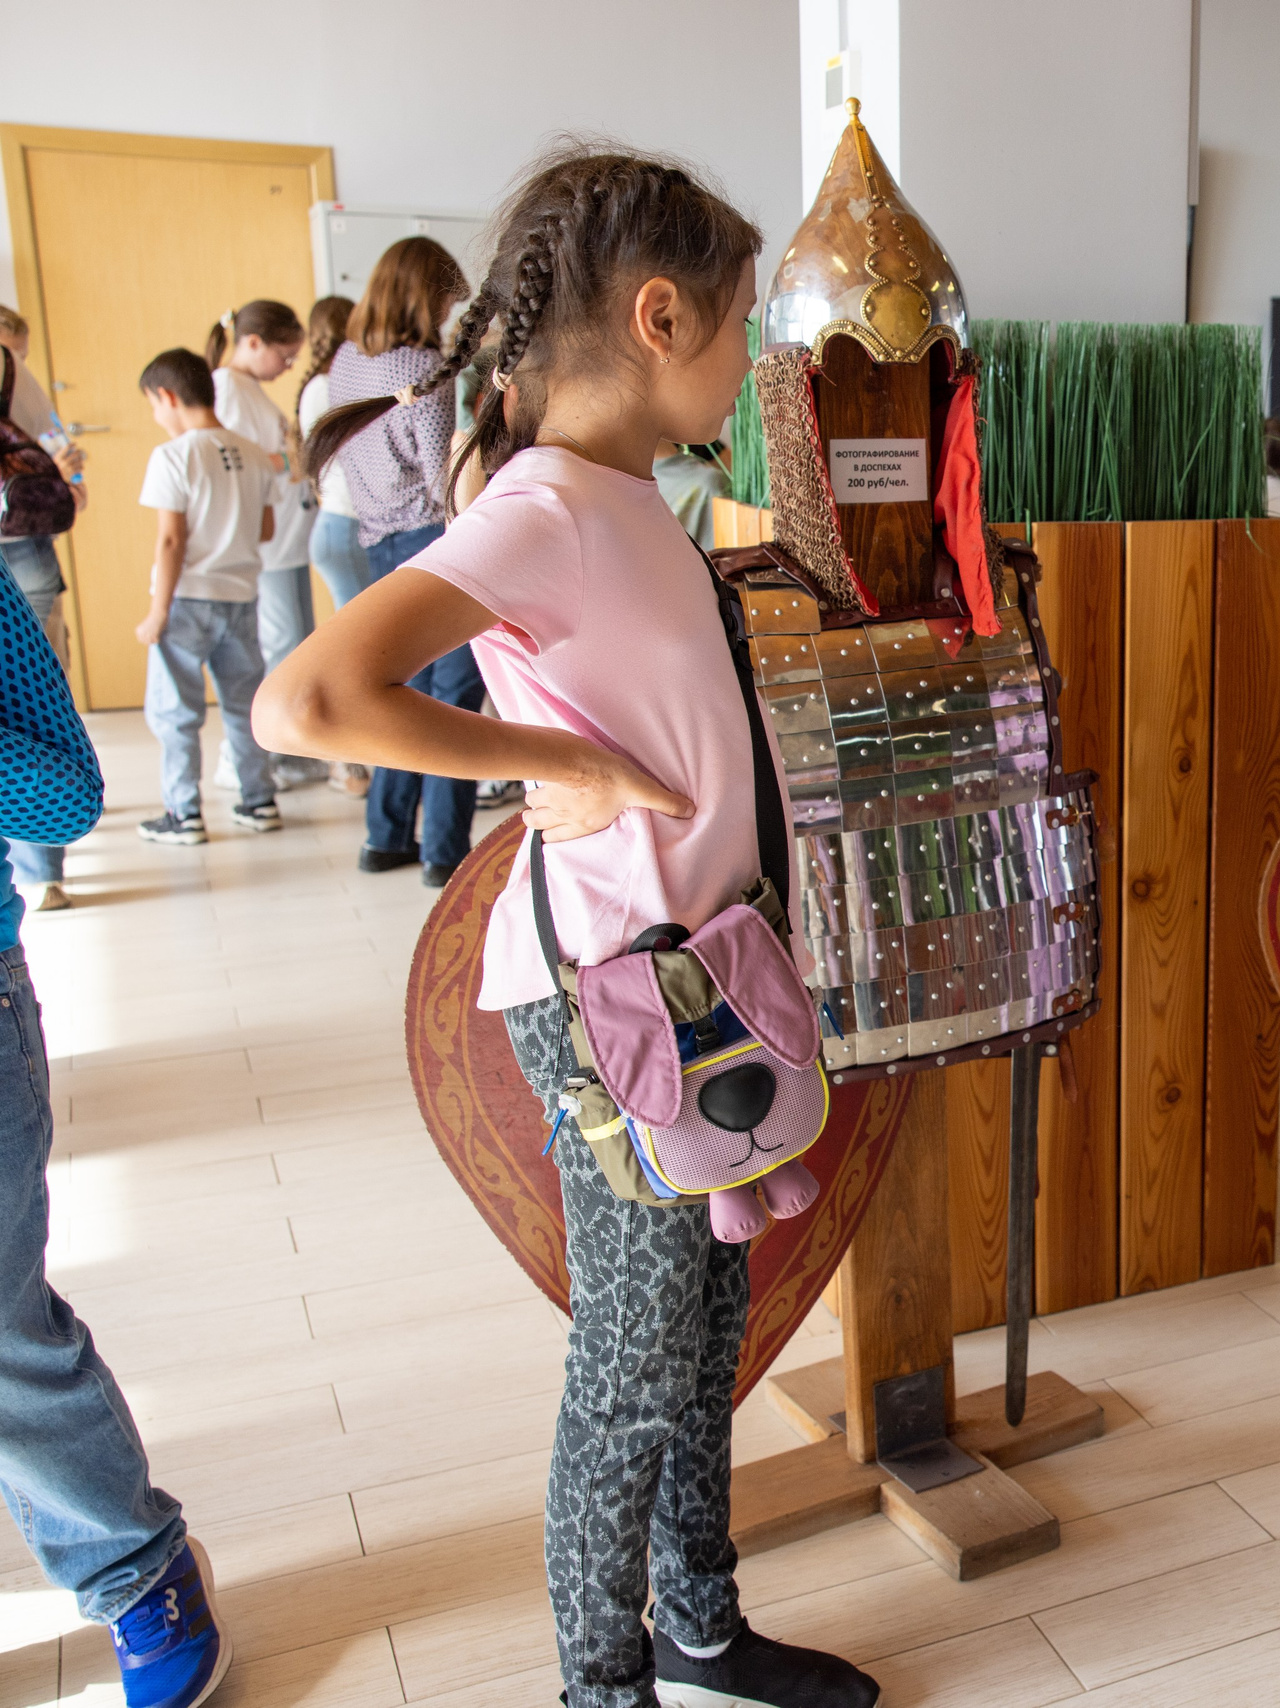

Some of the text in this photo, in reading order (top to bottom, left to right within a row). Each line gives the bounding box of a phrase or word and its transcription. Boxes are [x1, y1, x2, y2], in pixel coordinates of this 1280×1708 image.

[835, 450, 920, 459] ФОТОГРАФИРОВАНИЕ
[860, 463, 902, 473] ДОСПЕХАХ
[847, 477, 909, 489] 200 руб/чел.
